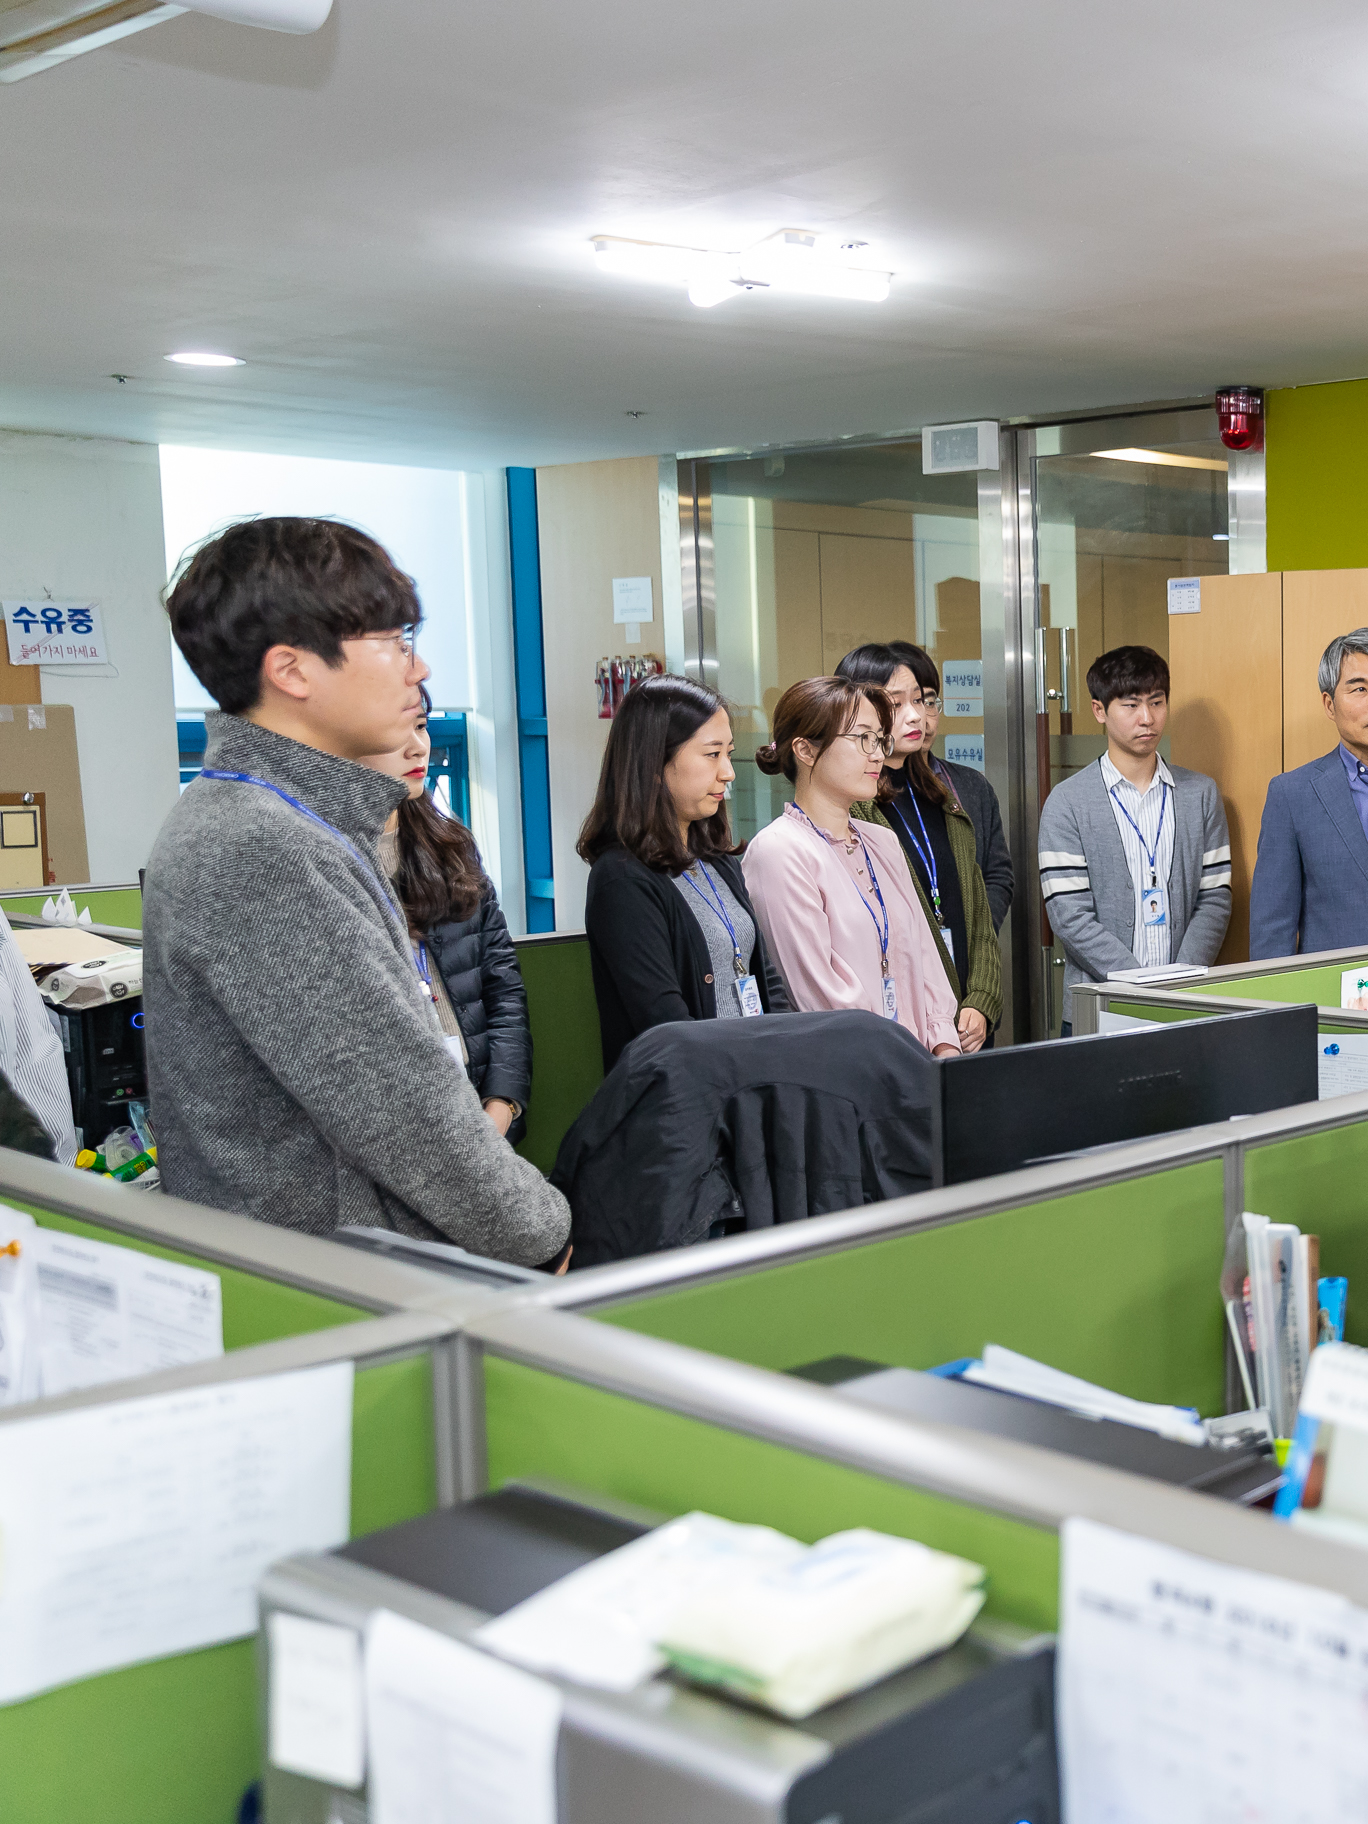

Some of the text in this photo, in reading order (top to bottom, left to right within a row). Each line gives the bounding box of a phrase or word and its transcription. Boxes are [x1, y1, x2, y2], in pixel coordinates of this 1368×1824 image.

[12, 606, 94, 635] 수유중
[20, 644, 99, 660] 들어가지 마세요
[944, 674, 981, 687] 복지상담실
[956, 703, 970, 712] 202
[947, 748, 983, 762] 모유수유실
